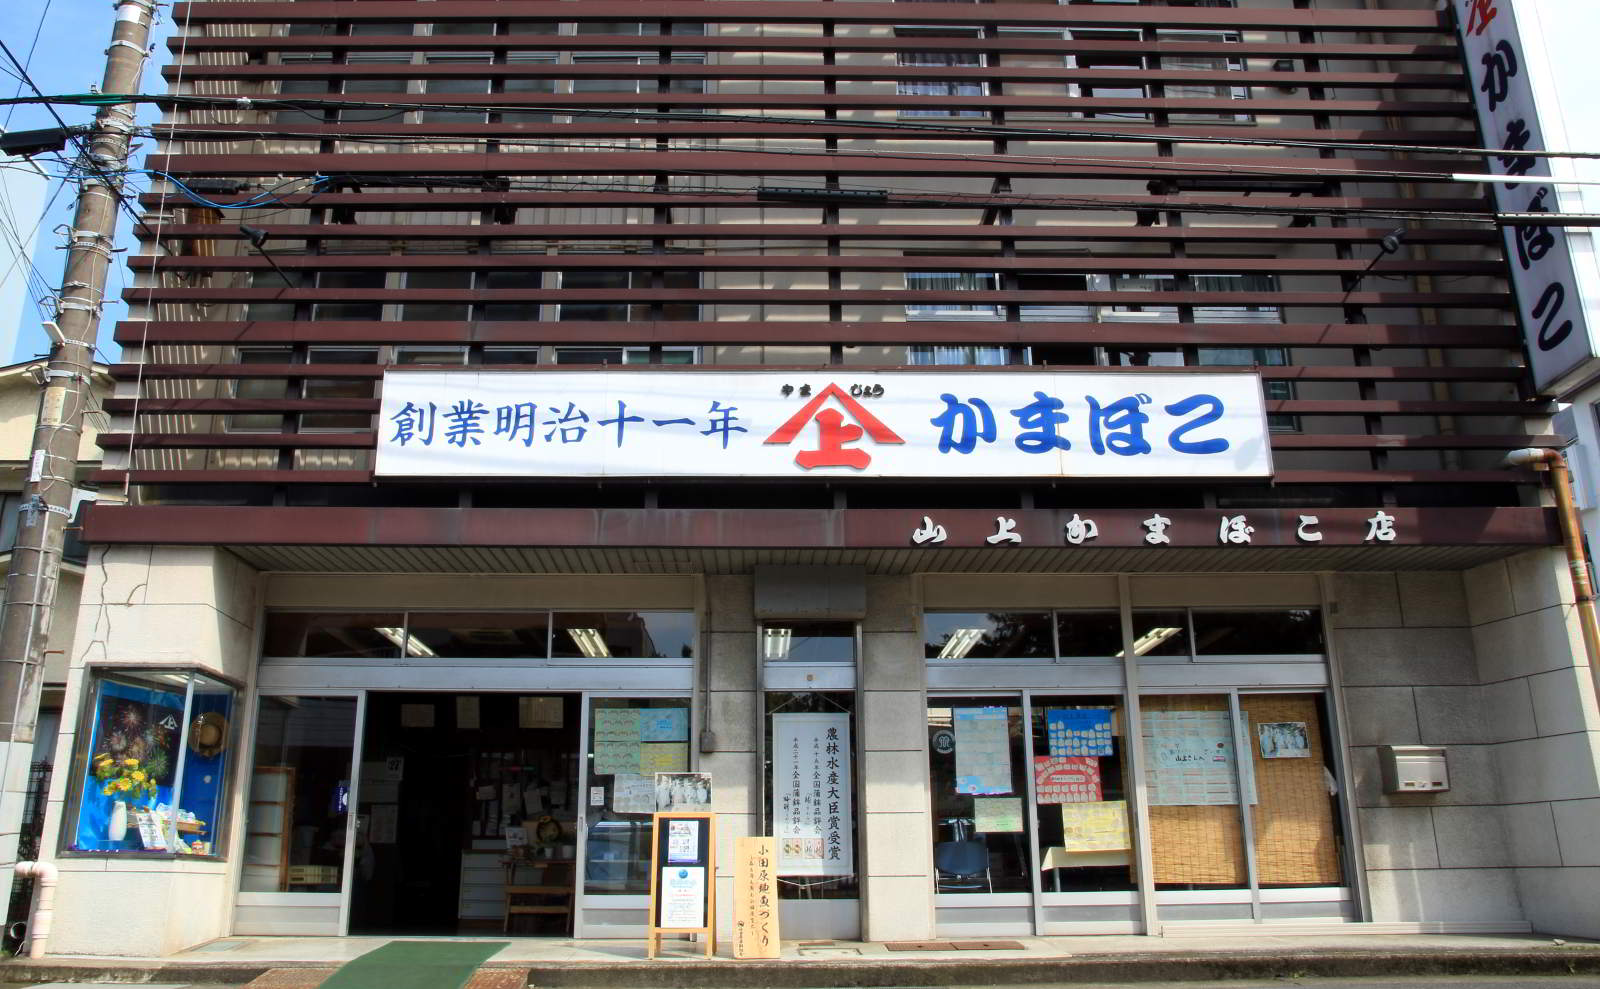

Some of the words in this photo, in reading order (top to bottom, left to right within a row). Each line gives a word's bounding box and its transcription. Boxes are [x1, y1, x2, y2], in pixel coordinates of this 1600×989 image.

[390, 399, 748, 449] 創業明治十一年
[930, 391, 1230, 456] かまぼこ
[912, 511, 1397, 544] 山上かまぼこ店
[825, 727, 841, 861] 農林水産大臣賞受賞
